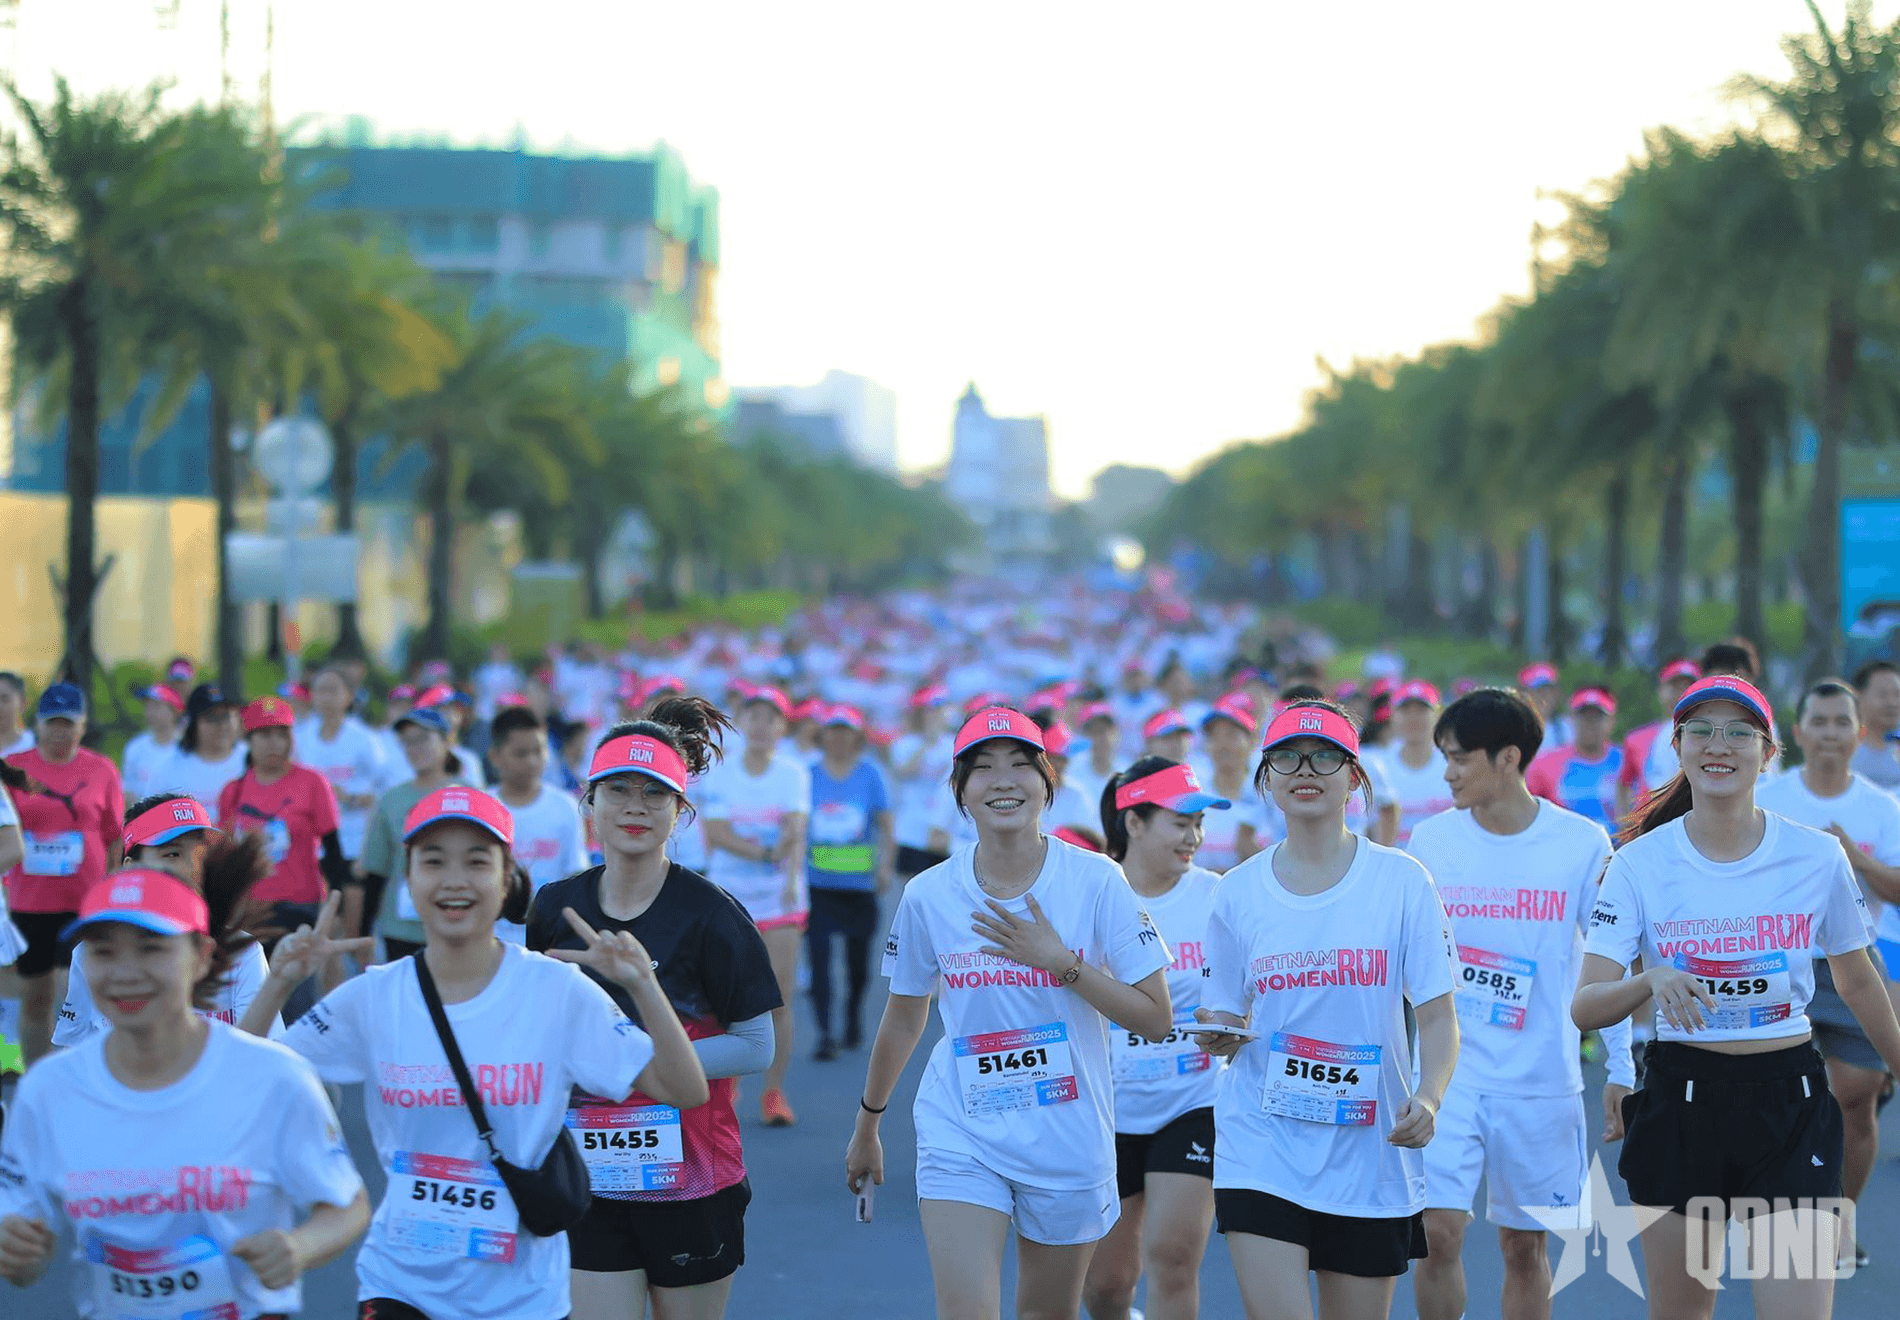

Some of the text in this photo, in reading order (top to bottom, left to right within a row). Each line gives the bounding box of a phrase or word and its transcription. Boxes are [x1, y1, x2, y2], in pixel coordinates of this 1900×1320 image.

[988, 719, 1011, 731] RUN
[1299, 718, 1322, 731] RUN
[629, 748, 654, 764] RUN
[173, 808, 195, 821] RUN
[1516, 888, 1567, 921] RUN
[1653, 916, 1755, 938] VIETNAM
[1755, 913, 1814, 951] RUN
[1657, 935, 1756, 958] WOMEN
[939, 952, 1030, 969] VIETNA
[1250, 949, 1337, 977] VIETNAM
[1337, 948, 1388, 986] RUN
[944, 968, 1031, 989] WOMEN
[1254, 970, 1338, 994] WOMEN
[1696, 978, 1768, 995] 1459
[978, 1048, 1048, 1075] 51461
[1284, 1057, 1360, 1085] 51654
[478, 1061, 544, 1106] RUN
[1045, 1088, 1069, 1100] 5KM
[1344, 1112, 1367, 1121] 5KM
[584, 1129, 659, 1149] 51455
[651, 1175, 676, 1184] 5KM
[412, 1180, 497, 1211] 51456
